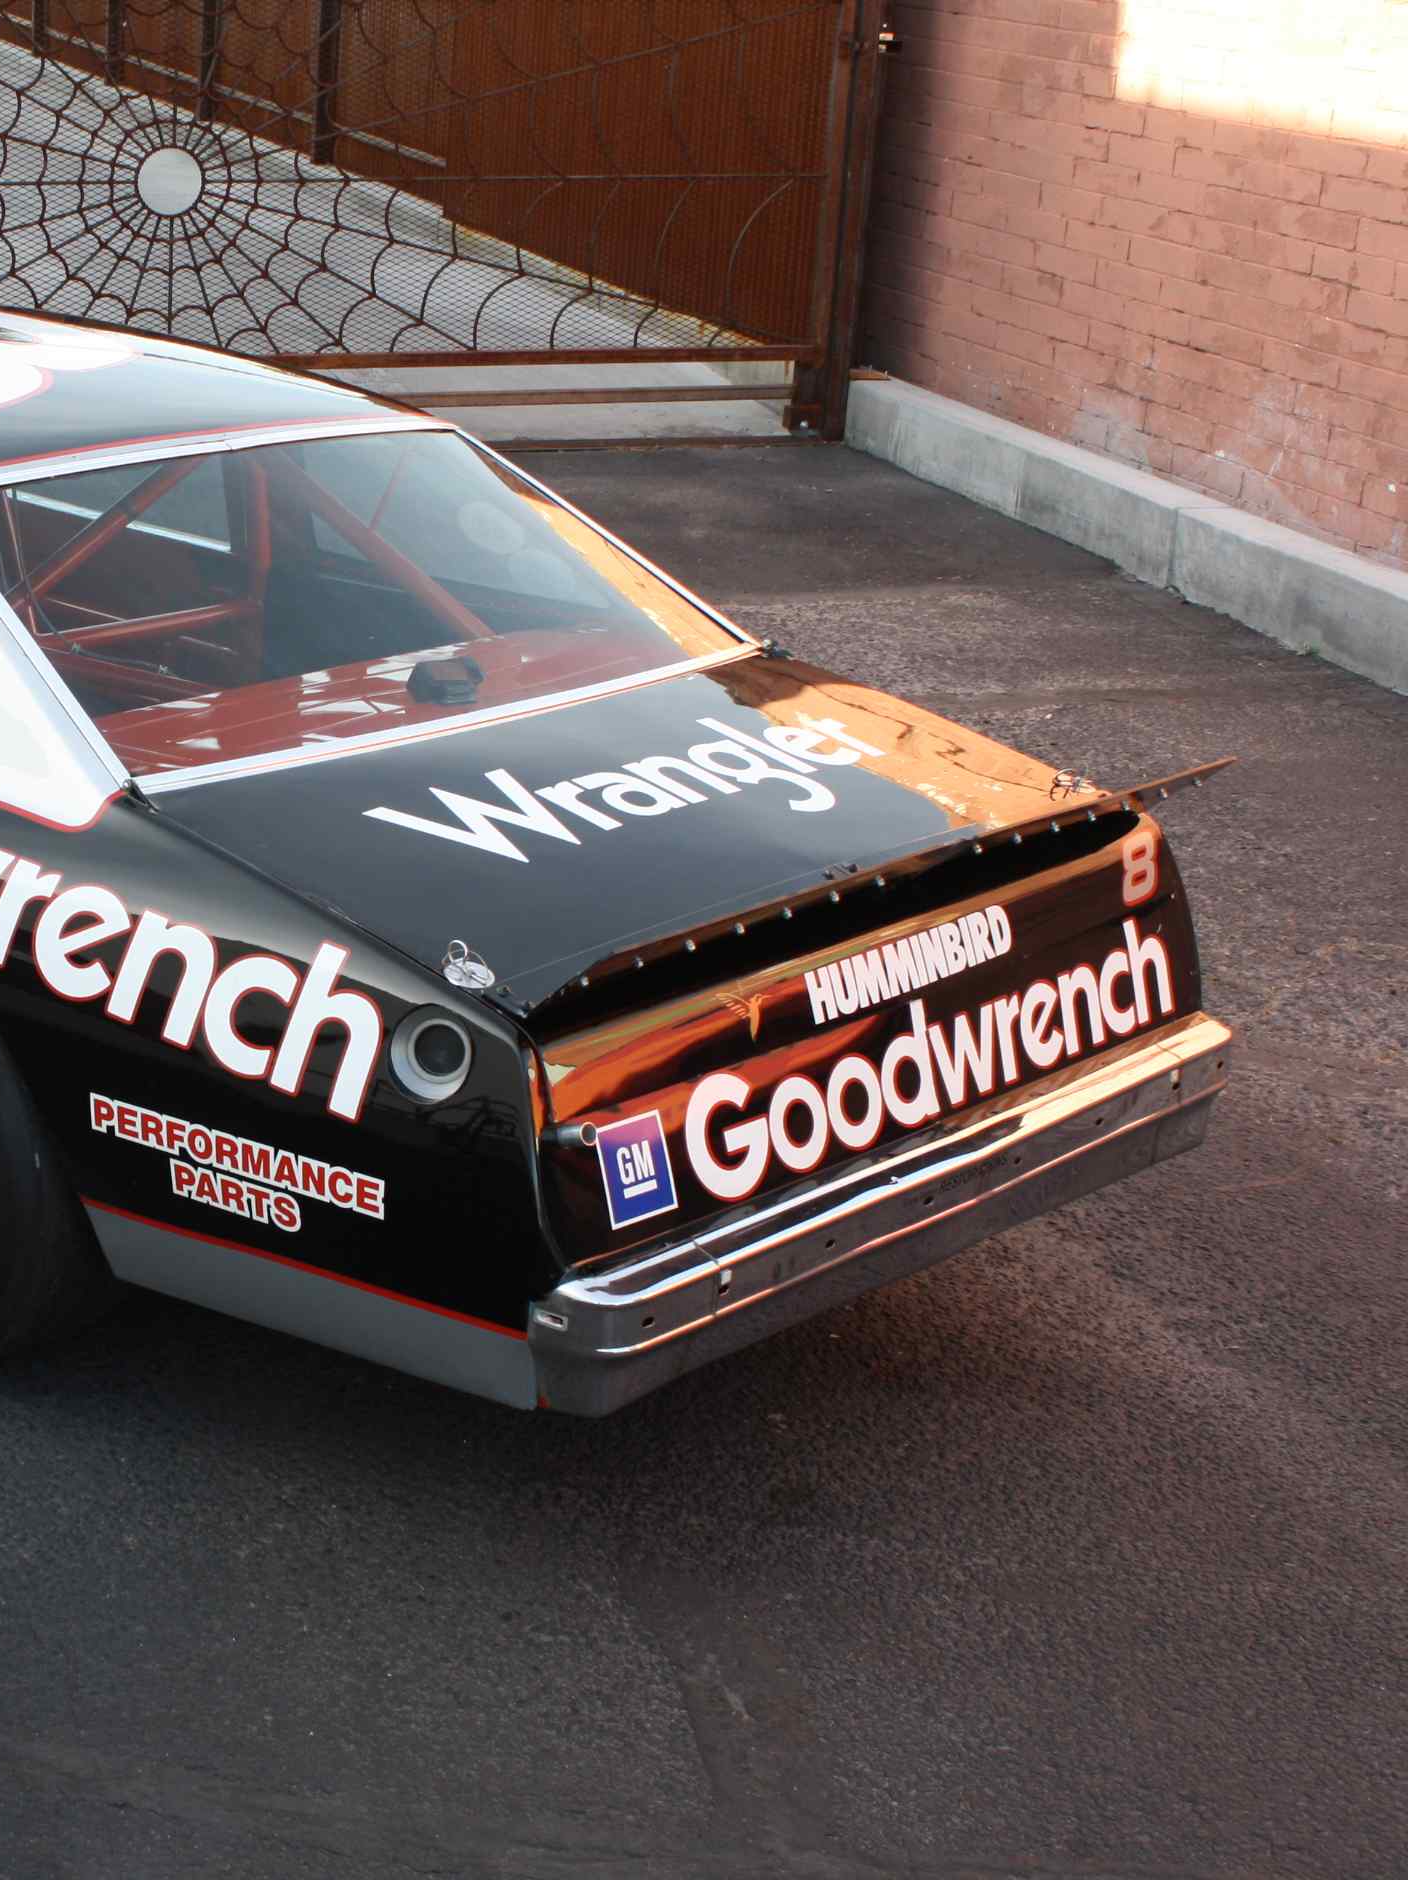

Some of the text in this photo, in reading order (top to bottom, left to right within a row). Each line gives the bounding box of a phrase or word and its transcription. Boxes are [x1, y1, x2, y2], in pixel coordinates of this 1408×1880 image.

[361, 716, 886, 864] Wrangler
[1120, 829, 1160, 907] 8
[803, 904, 1013, 1026] HUMMINBIRD
[684, 917, 1176, 1202] Goodwrench
[90, 1093, 385, 1220] PERFORMANCE
[170, 1158, 301, 1232] PARTS
[616, 1140, 656, 1186] GM
